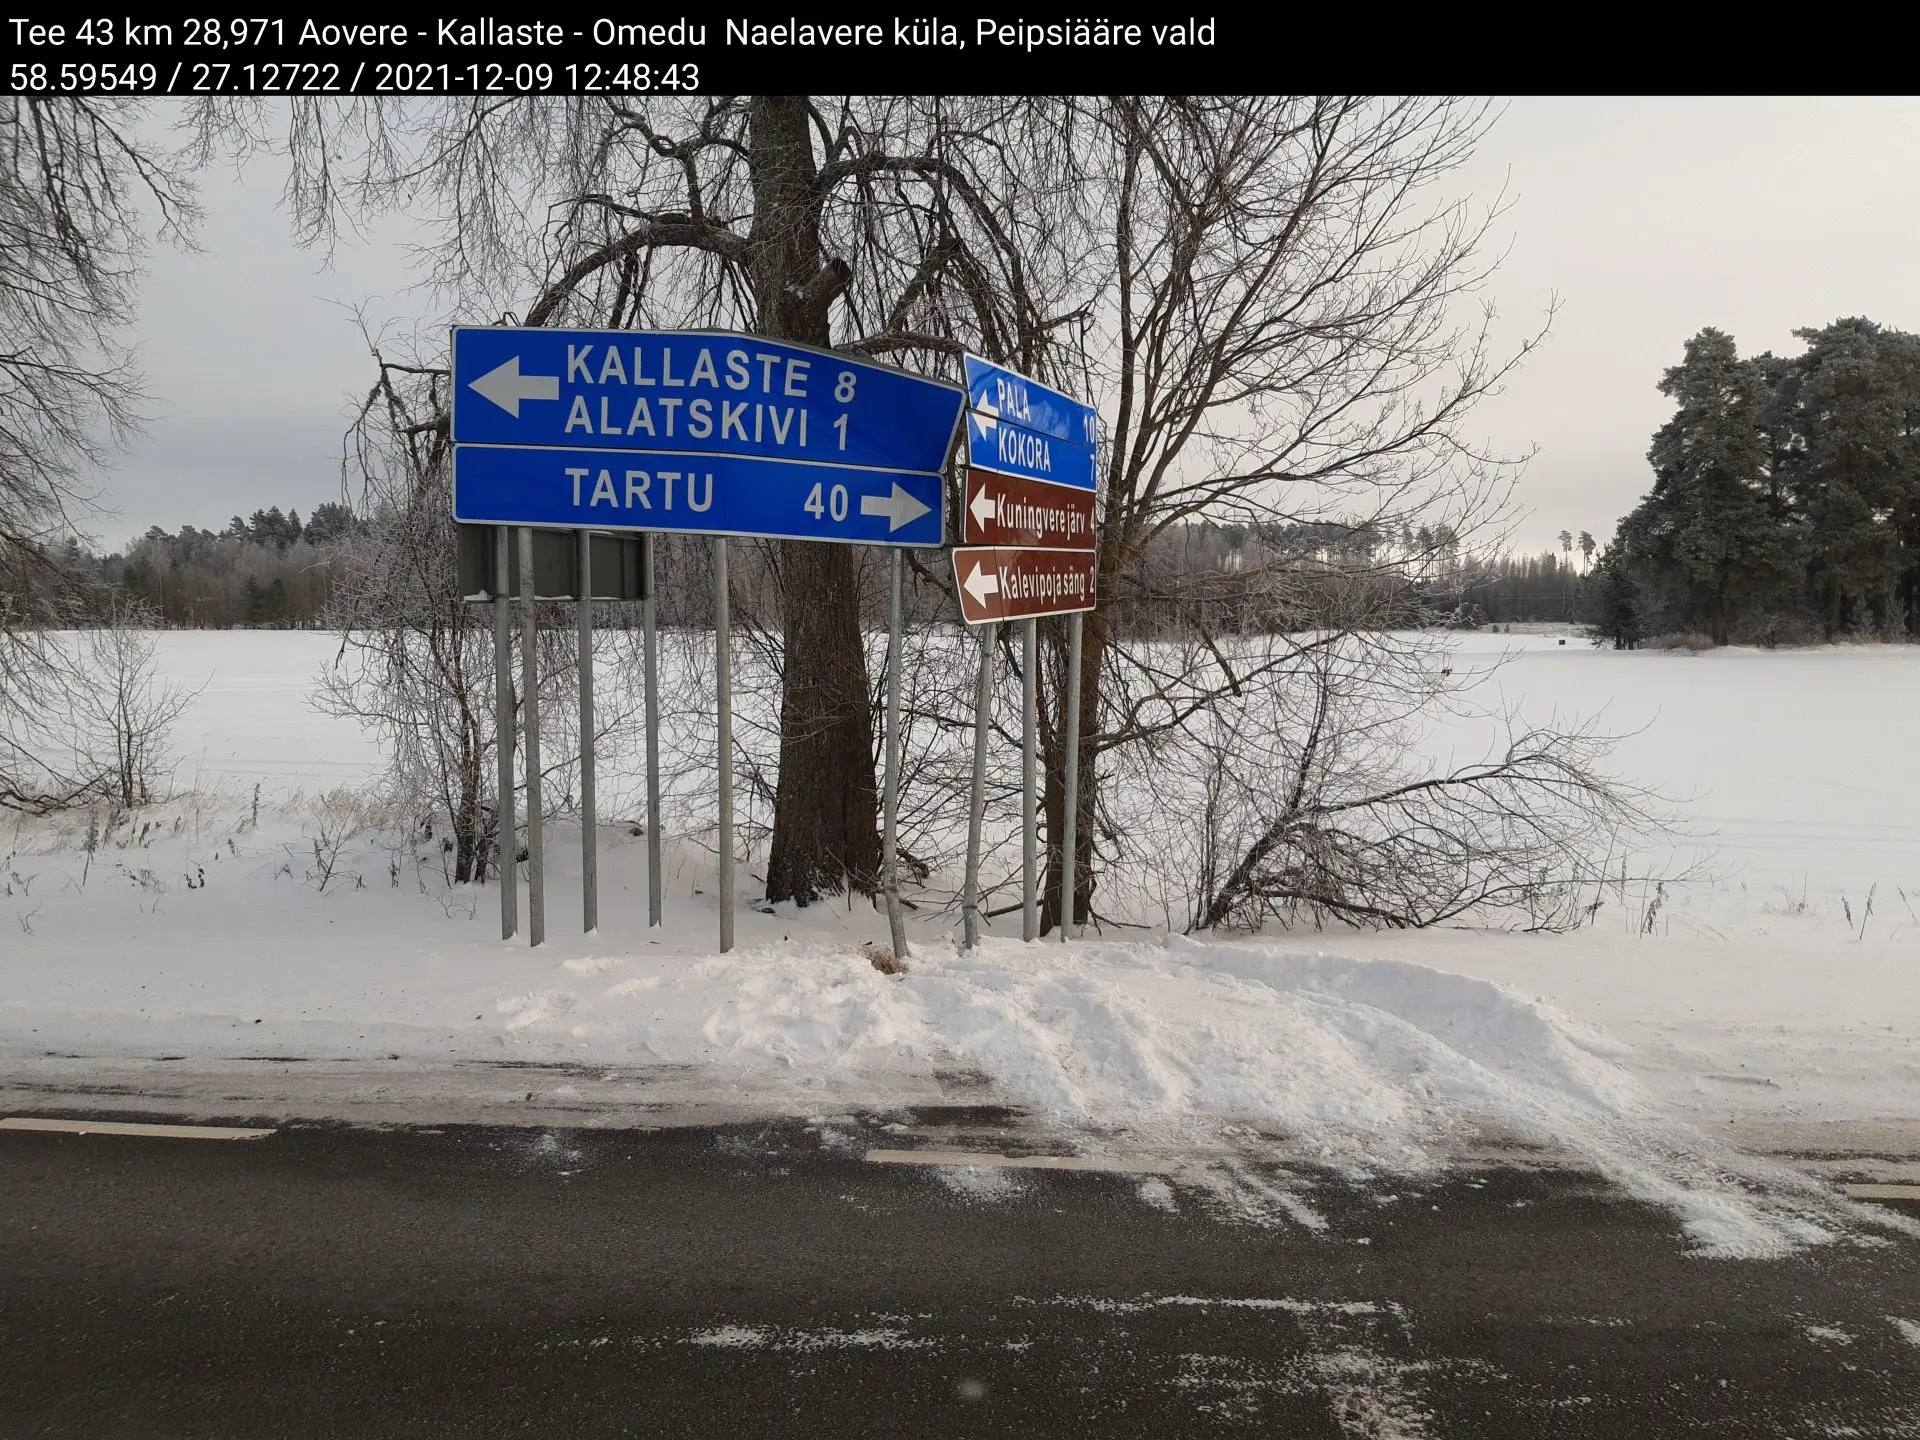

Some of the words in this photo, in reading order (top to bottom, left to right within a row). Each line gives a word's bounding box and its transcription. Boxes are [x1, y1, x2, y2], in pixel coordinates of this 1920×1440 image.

[566, 344, 812, 398] KALLASTE
[835, 371, 857, 404] 8
[564, 395, 808, 447] ALATSKIVI
[833, 413, 849, 451] 1
[998, 379, 1030, 421] PALA
[1083, 413, 1095, 444] 10
[998, 428, 1051, 473] KOKORA
[1090, 454, 1095, 483] 7
[565, 467, 714, 513] TARTU
[803, 482, 850, 522] 40
[997, 493, 1066, 539] Kuningvere
[1066, 503, 1085, 543] järv
[1090, 506, 1095, 535] 4
[999, 566, 1063, 605] Kalevipoja
[1063, 566, 1085, 602] säng
[1089, 565, 1095, 594] 2
